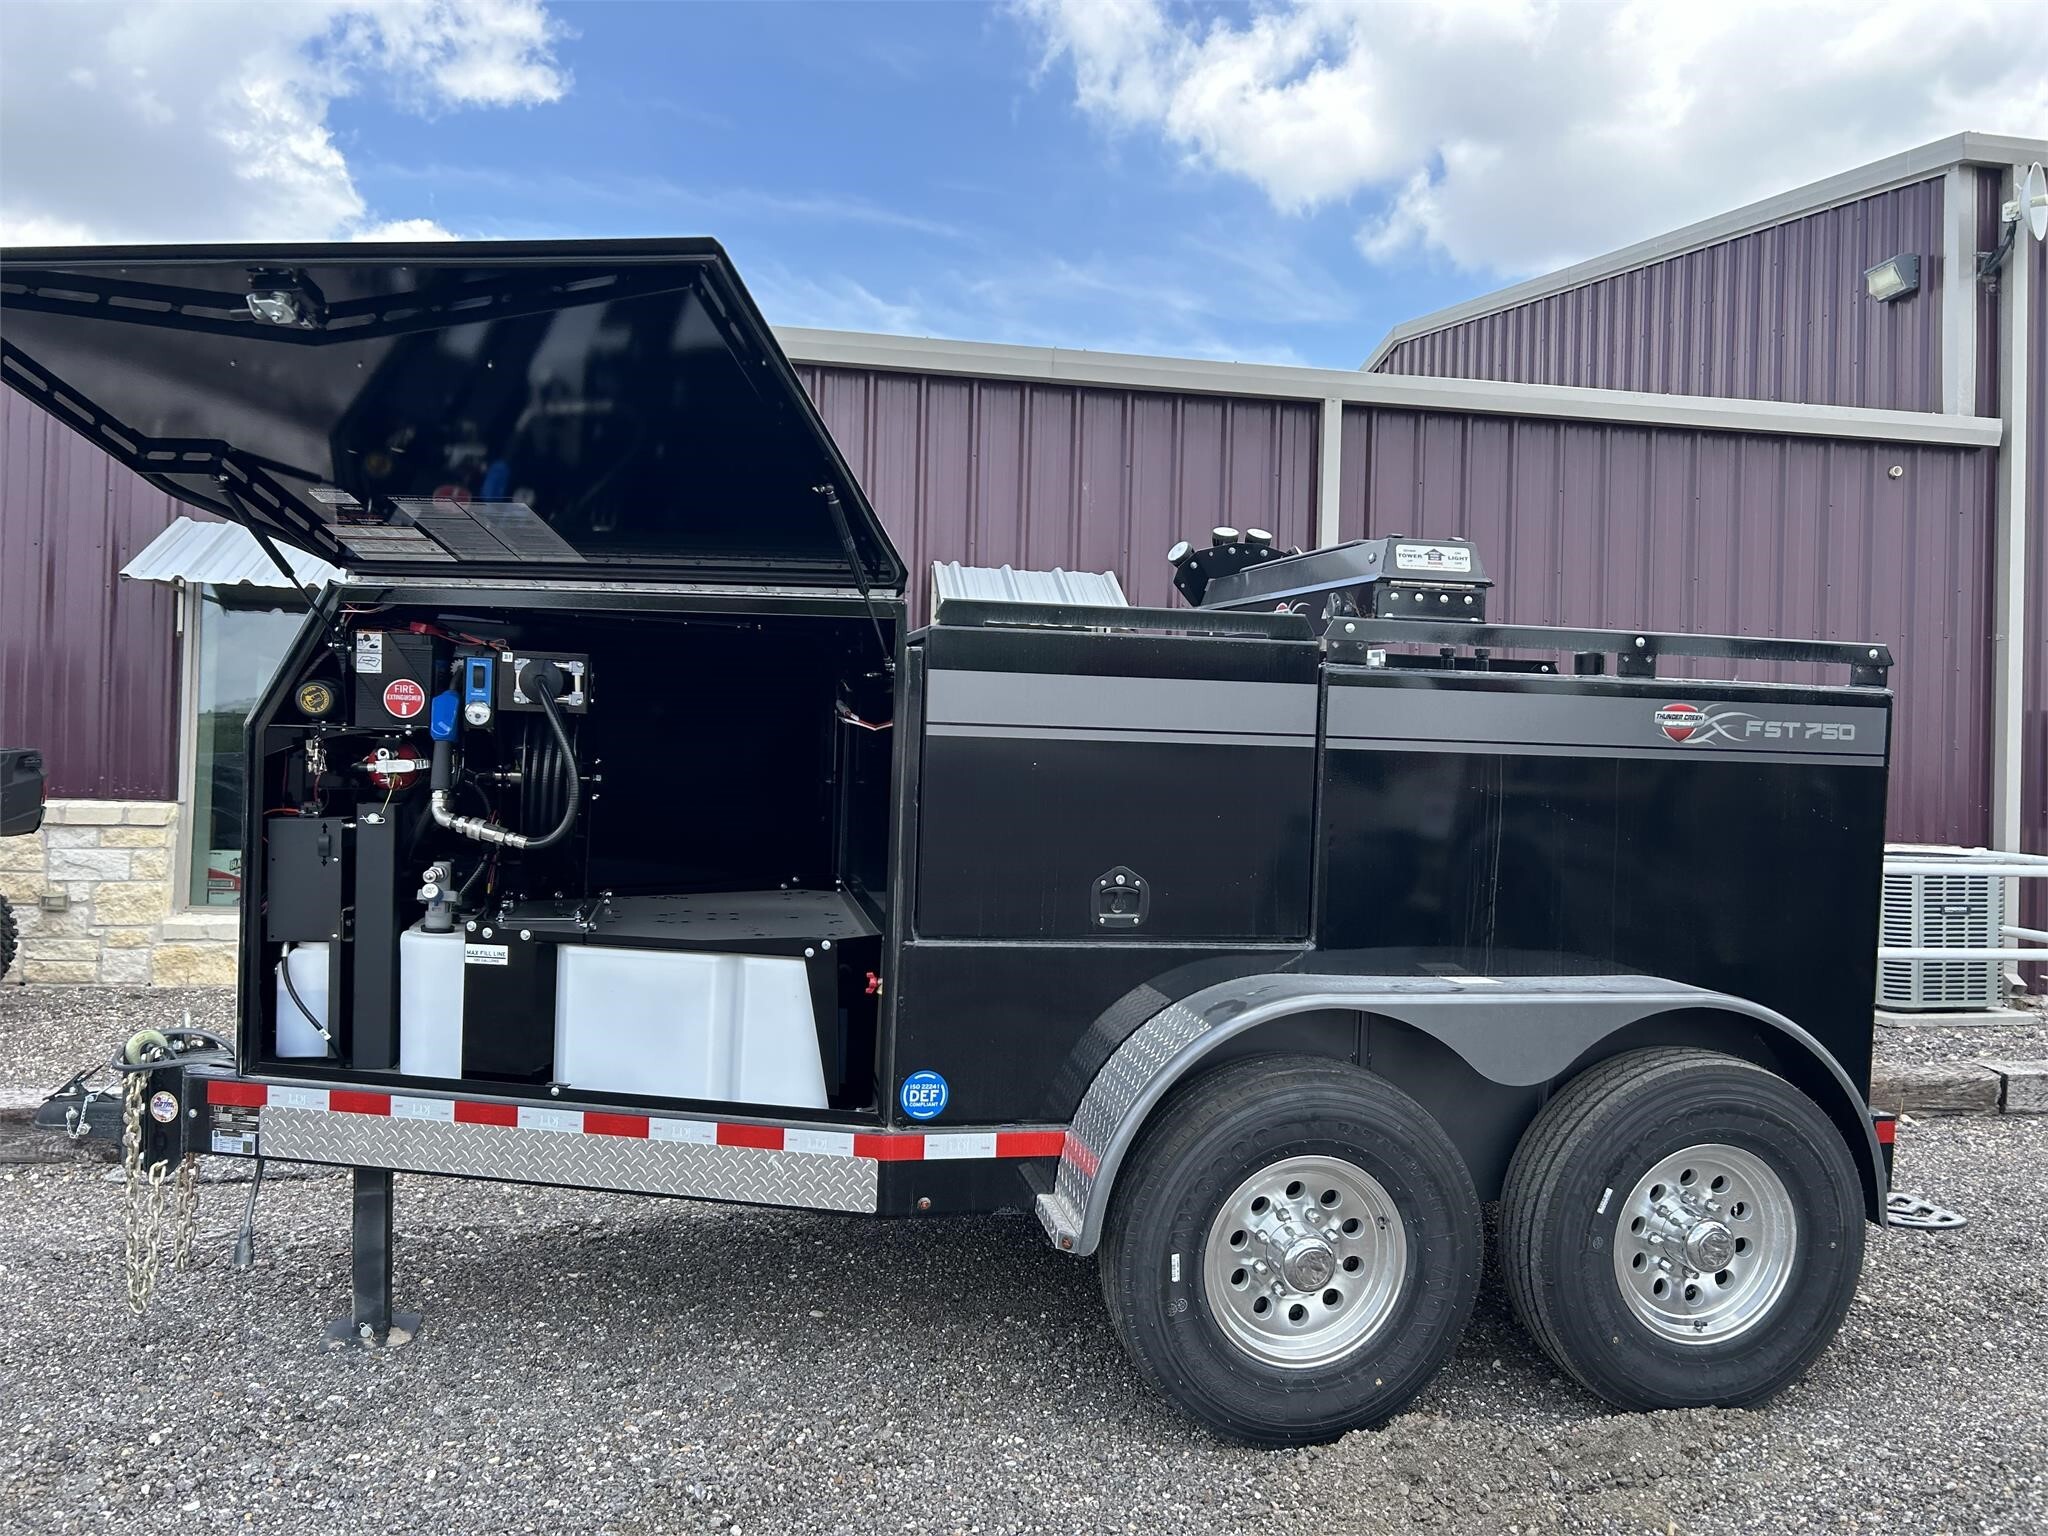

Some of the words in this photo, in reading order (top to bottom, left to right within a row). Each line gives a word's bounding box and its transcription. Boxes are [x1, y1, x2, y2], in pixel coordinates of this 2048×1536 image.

[394, 684, 415, 694] FIRE
[1745, 720, 1801, 739] FST
[1804, 722, 1856, 741] 750
[909, 1089, 940, 1102] DEF
